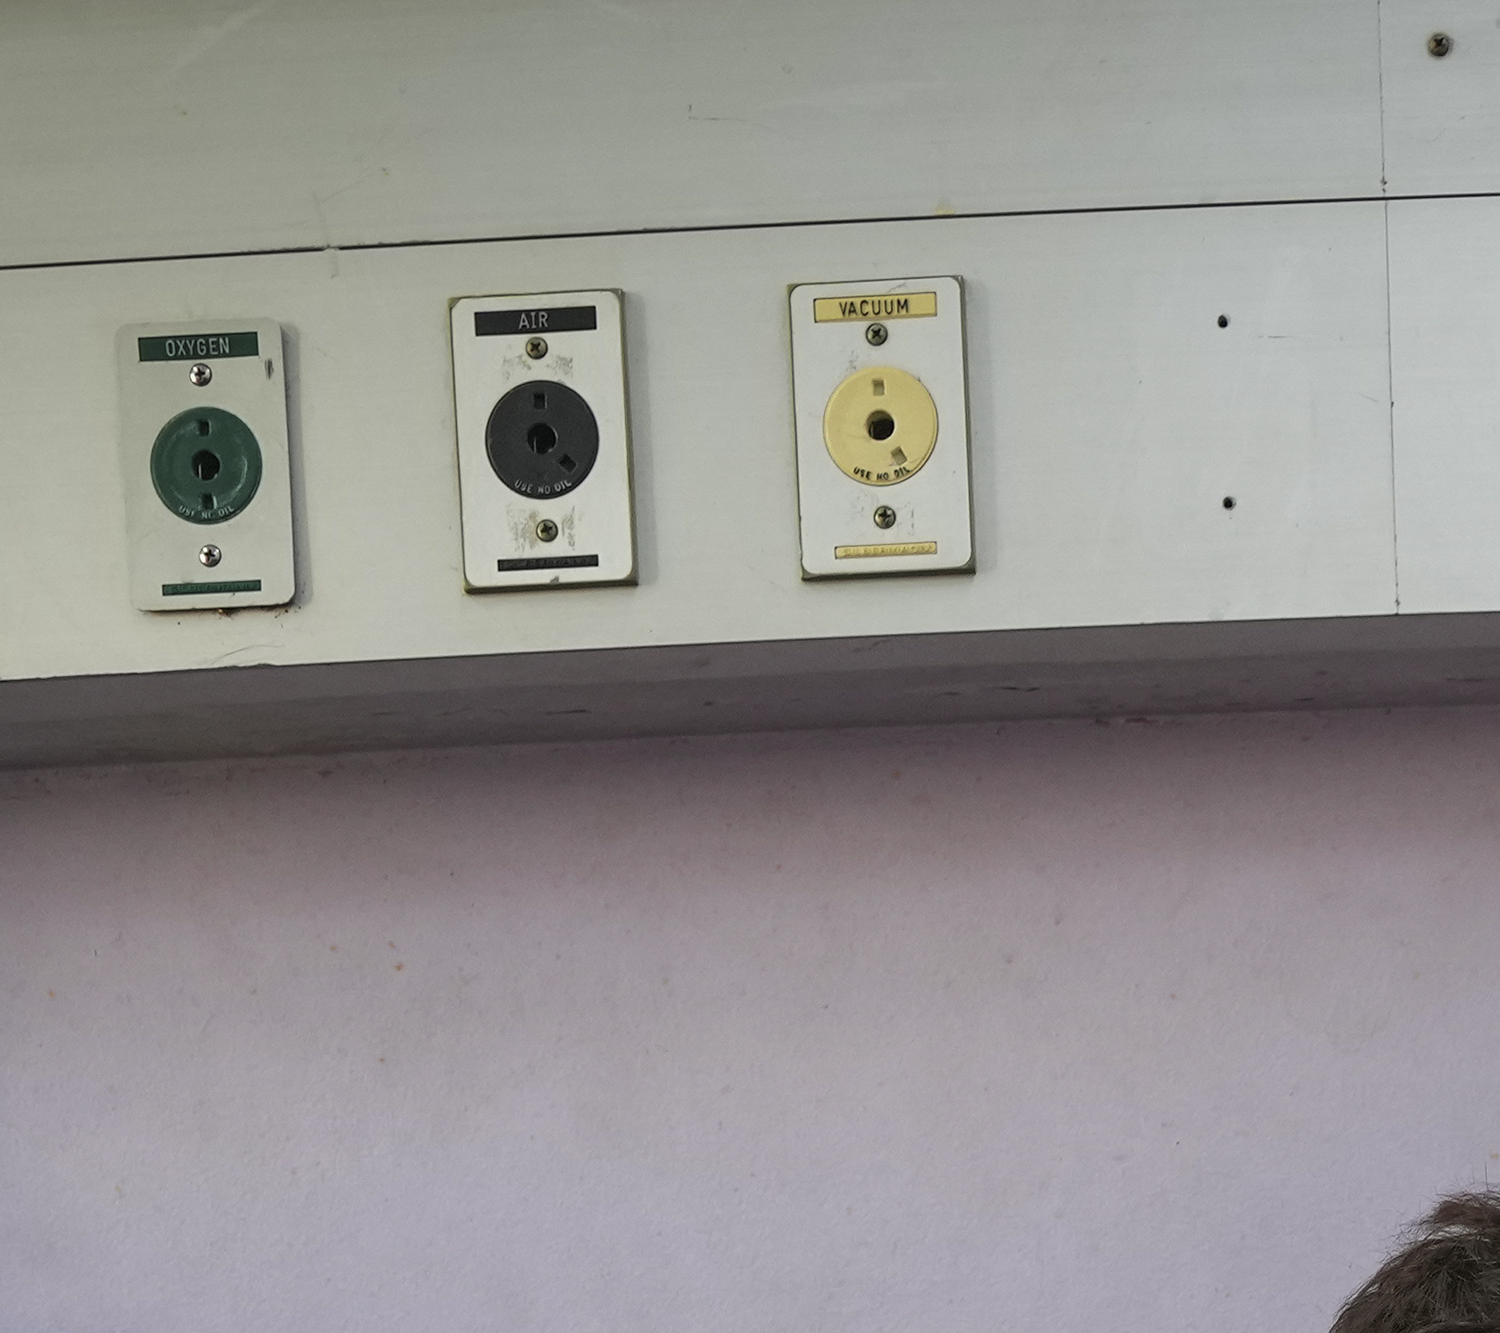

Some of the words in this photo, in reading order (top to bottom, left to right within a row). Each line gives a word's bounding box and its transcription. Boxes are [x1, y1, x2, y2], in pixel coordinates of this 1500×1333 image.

[838, 298, 910, 318] VACUUM
[518, 311, 549, 330] AIR
[166, 337, 230, 357] OXYGEN
[853, 466, 872, 480] USE
[893, 466, 911, 480] OIL
[514, 480, 534, 494] USE
[537, 485, 551, 494] NO
[554, 479, 572, 491] OIL
